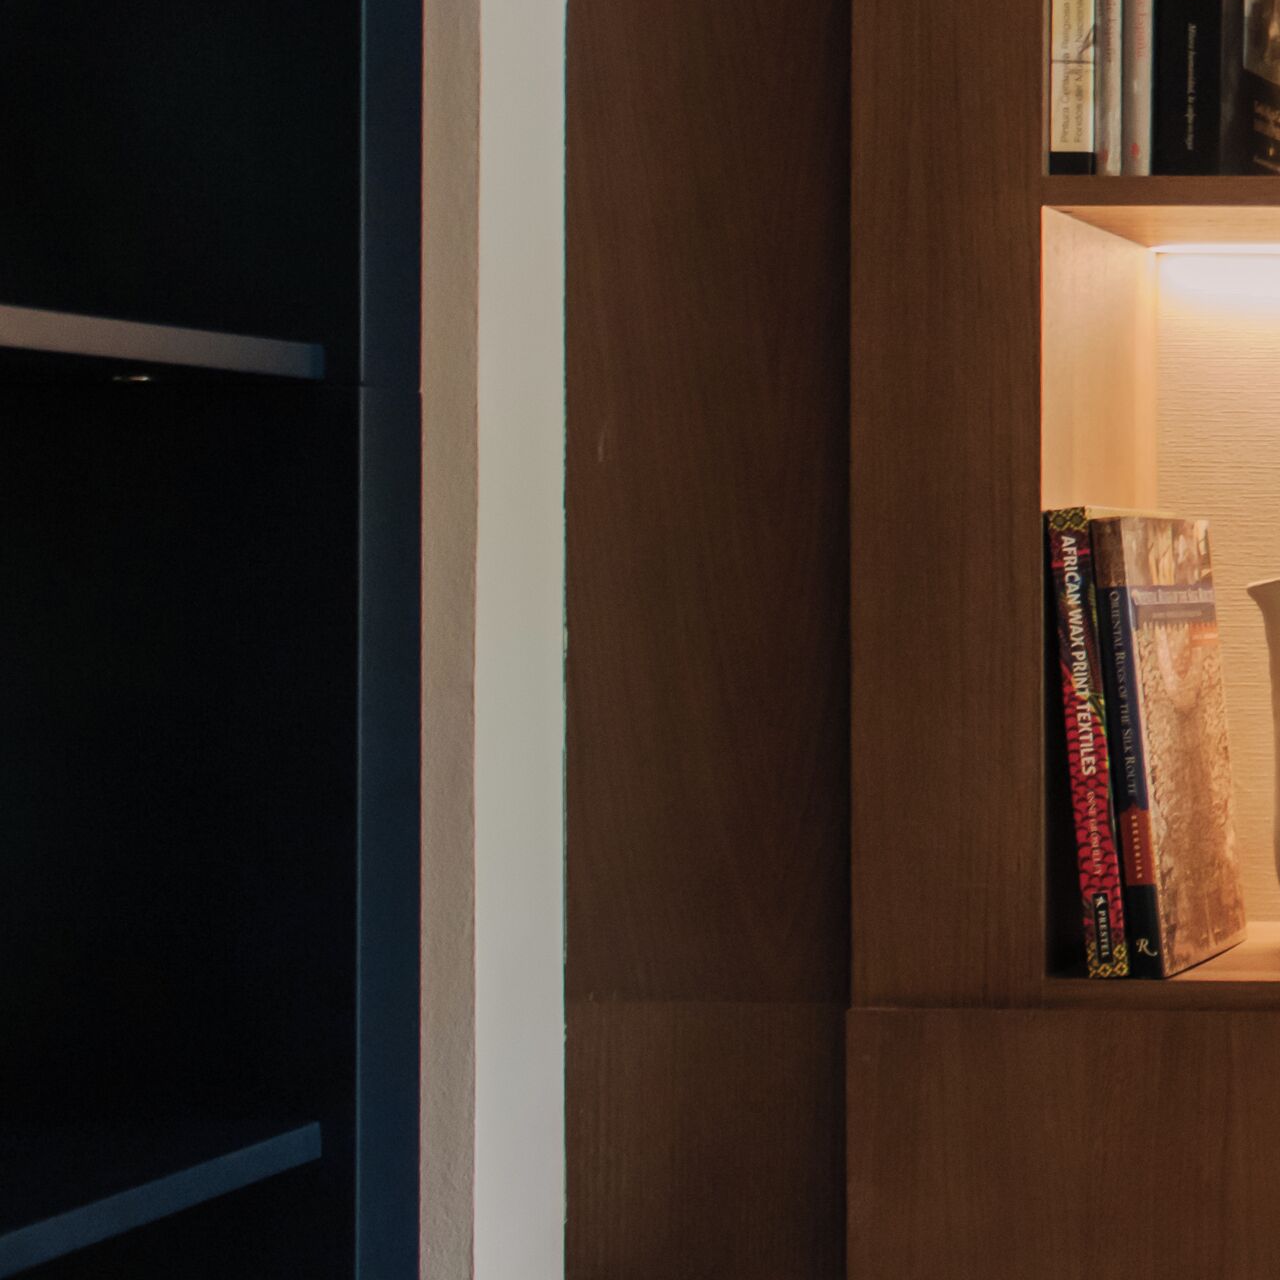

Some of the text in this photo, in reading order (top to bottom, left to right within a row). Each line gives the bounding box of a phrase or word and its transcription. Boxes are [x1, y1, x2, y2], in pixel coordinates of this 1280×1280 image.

[1060, 107, 1071, 144] Pintura
[1073, 104, 1083, 144] Fondos
[1060, 535, 1097, 776] AFRICAN WAX PRINT TEXTILES
[1109, 590, 1138, 798] ORIENTAL RUGS OF THE SILK ROUTE
[1097, 909, 1110, 958] PRESTEL
